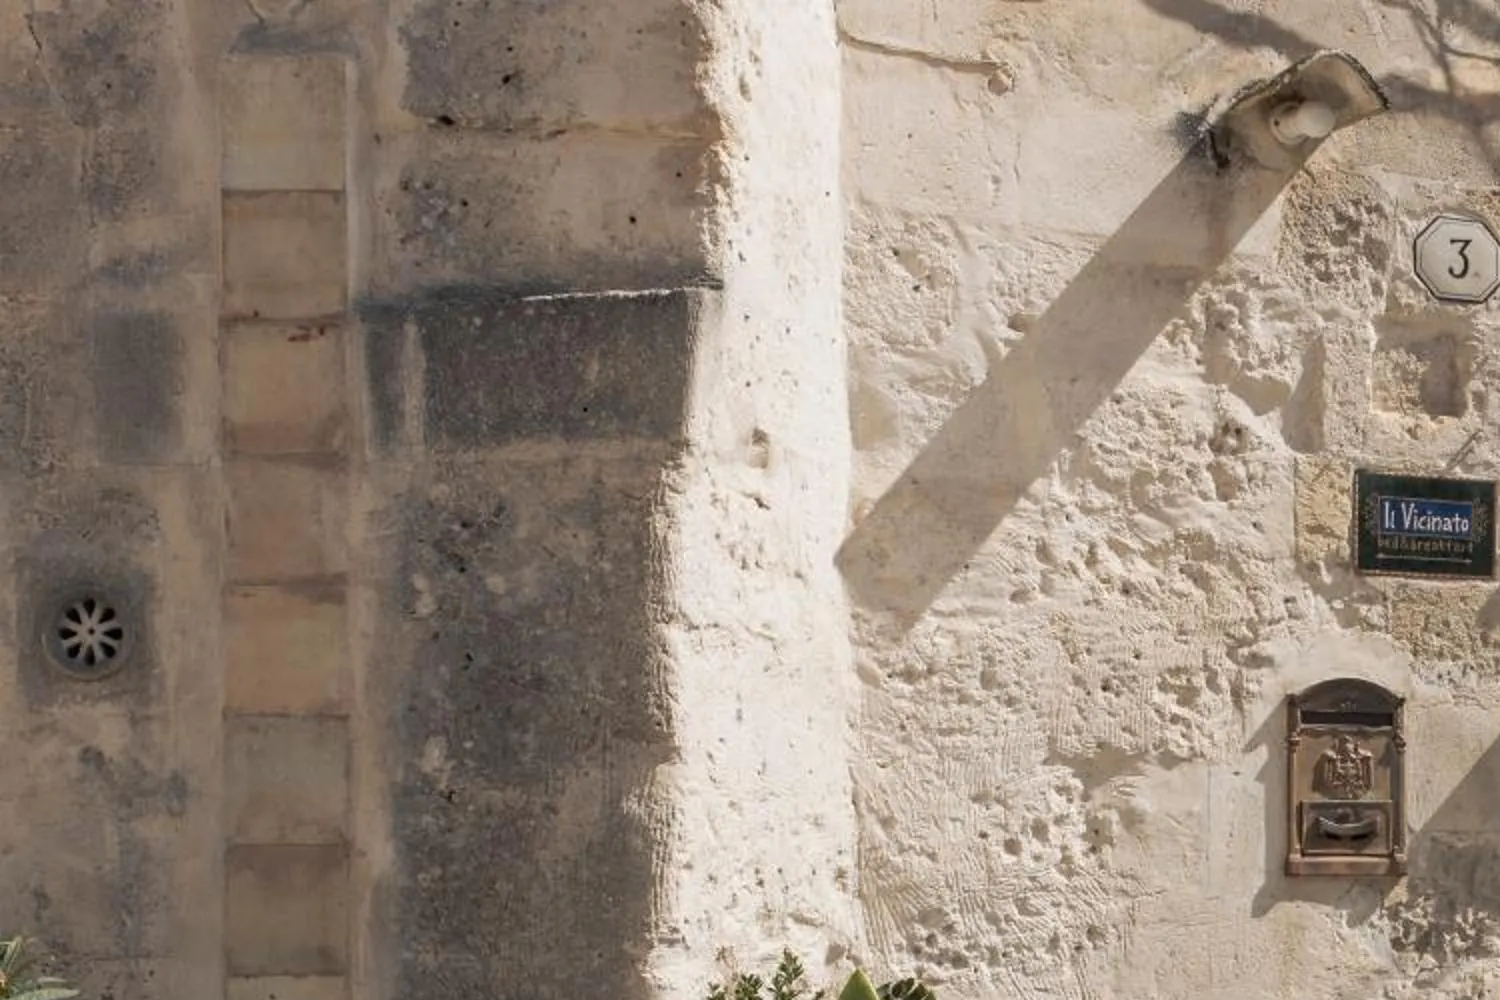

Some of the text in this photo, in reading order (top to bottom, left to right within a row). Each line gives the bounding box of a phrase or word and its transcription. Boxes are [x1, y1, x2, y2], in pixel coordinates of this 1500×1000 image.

[1448, 238, 1473, 279] 3
[1384, 501, 1469, 533] Il Vicinato
